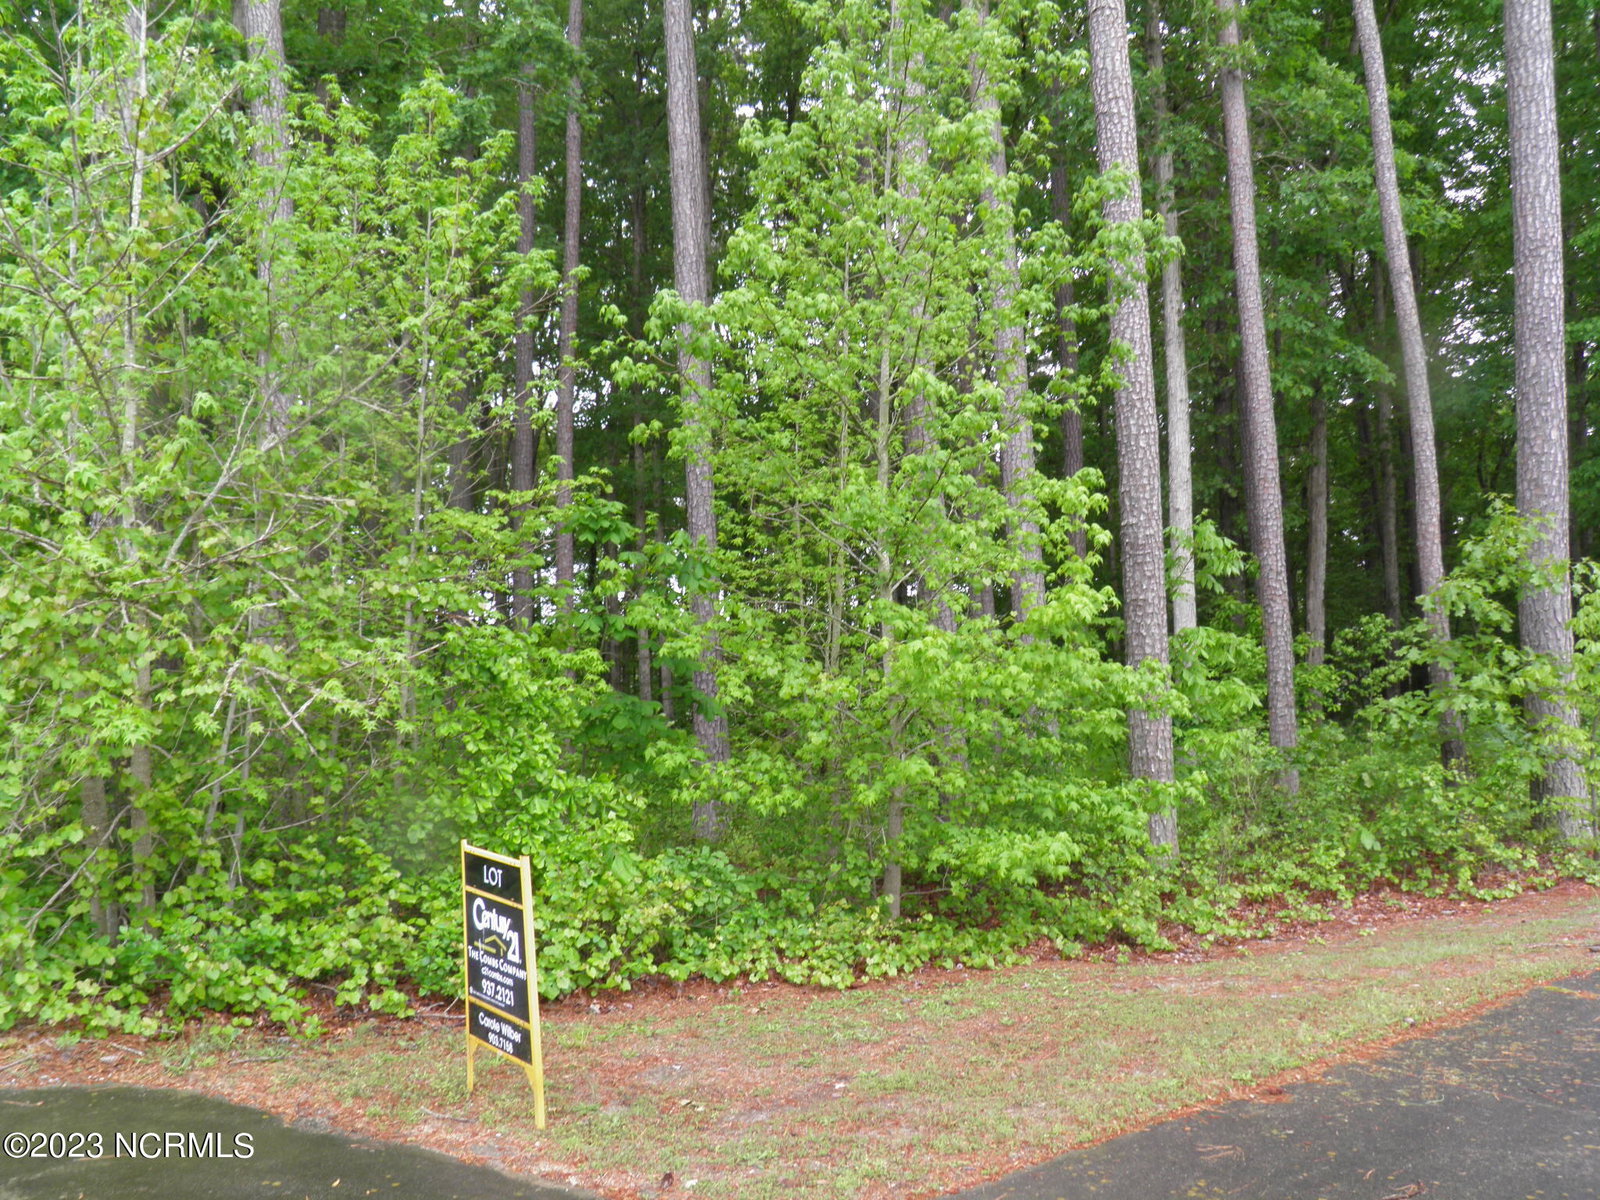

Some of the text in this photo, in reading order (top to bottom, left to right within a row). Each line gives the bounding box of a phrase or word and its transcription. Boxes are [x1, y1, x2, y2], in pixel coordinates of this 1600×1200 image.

[483, 865, 503, 888] LOT
[472, 897, 511, 940] Century
[468, 945, 479, 961] THE
[499, 959, 527, 981] COMPANY
[481, 979, 515, 1007] 937.2121
